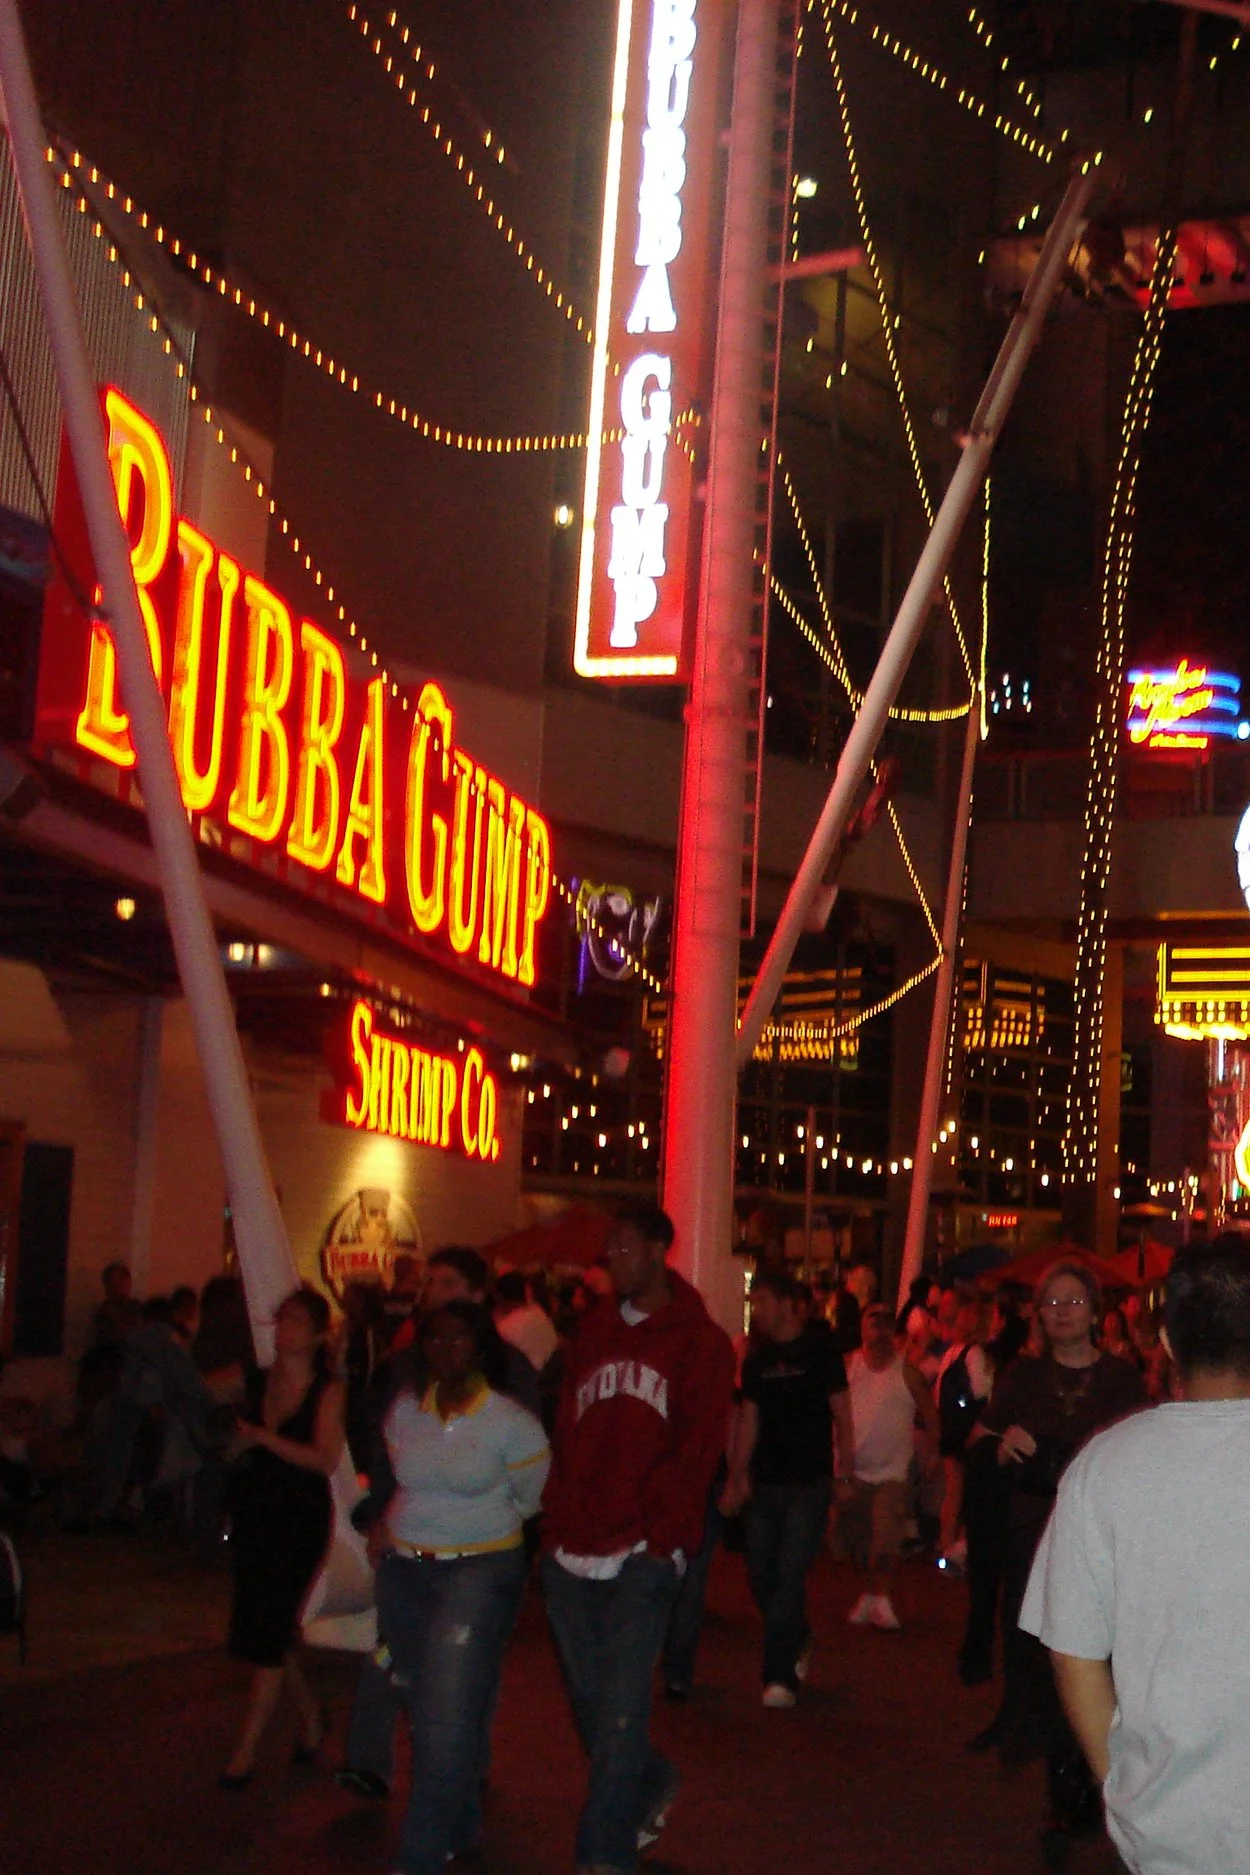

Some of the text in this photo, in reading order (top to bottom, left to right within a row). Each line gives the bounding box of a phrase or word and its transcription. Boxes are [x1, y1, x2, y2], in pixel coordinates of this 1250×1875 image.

[609, 0, 697, 649] BUBBA GUMP
[404, 682, 554, 986] GUMP
[346, 999, 458, 1148] SHRIMP
